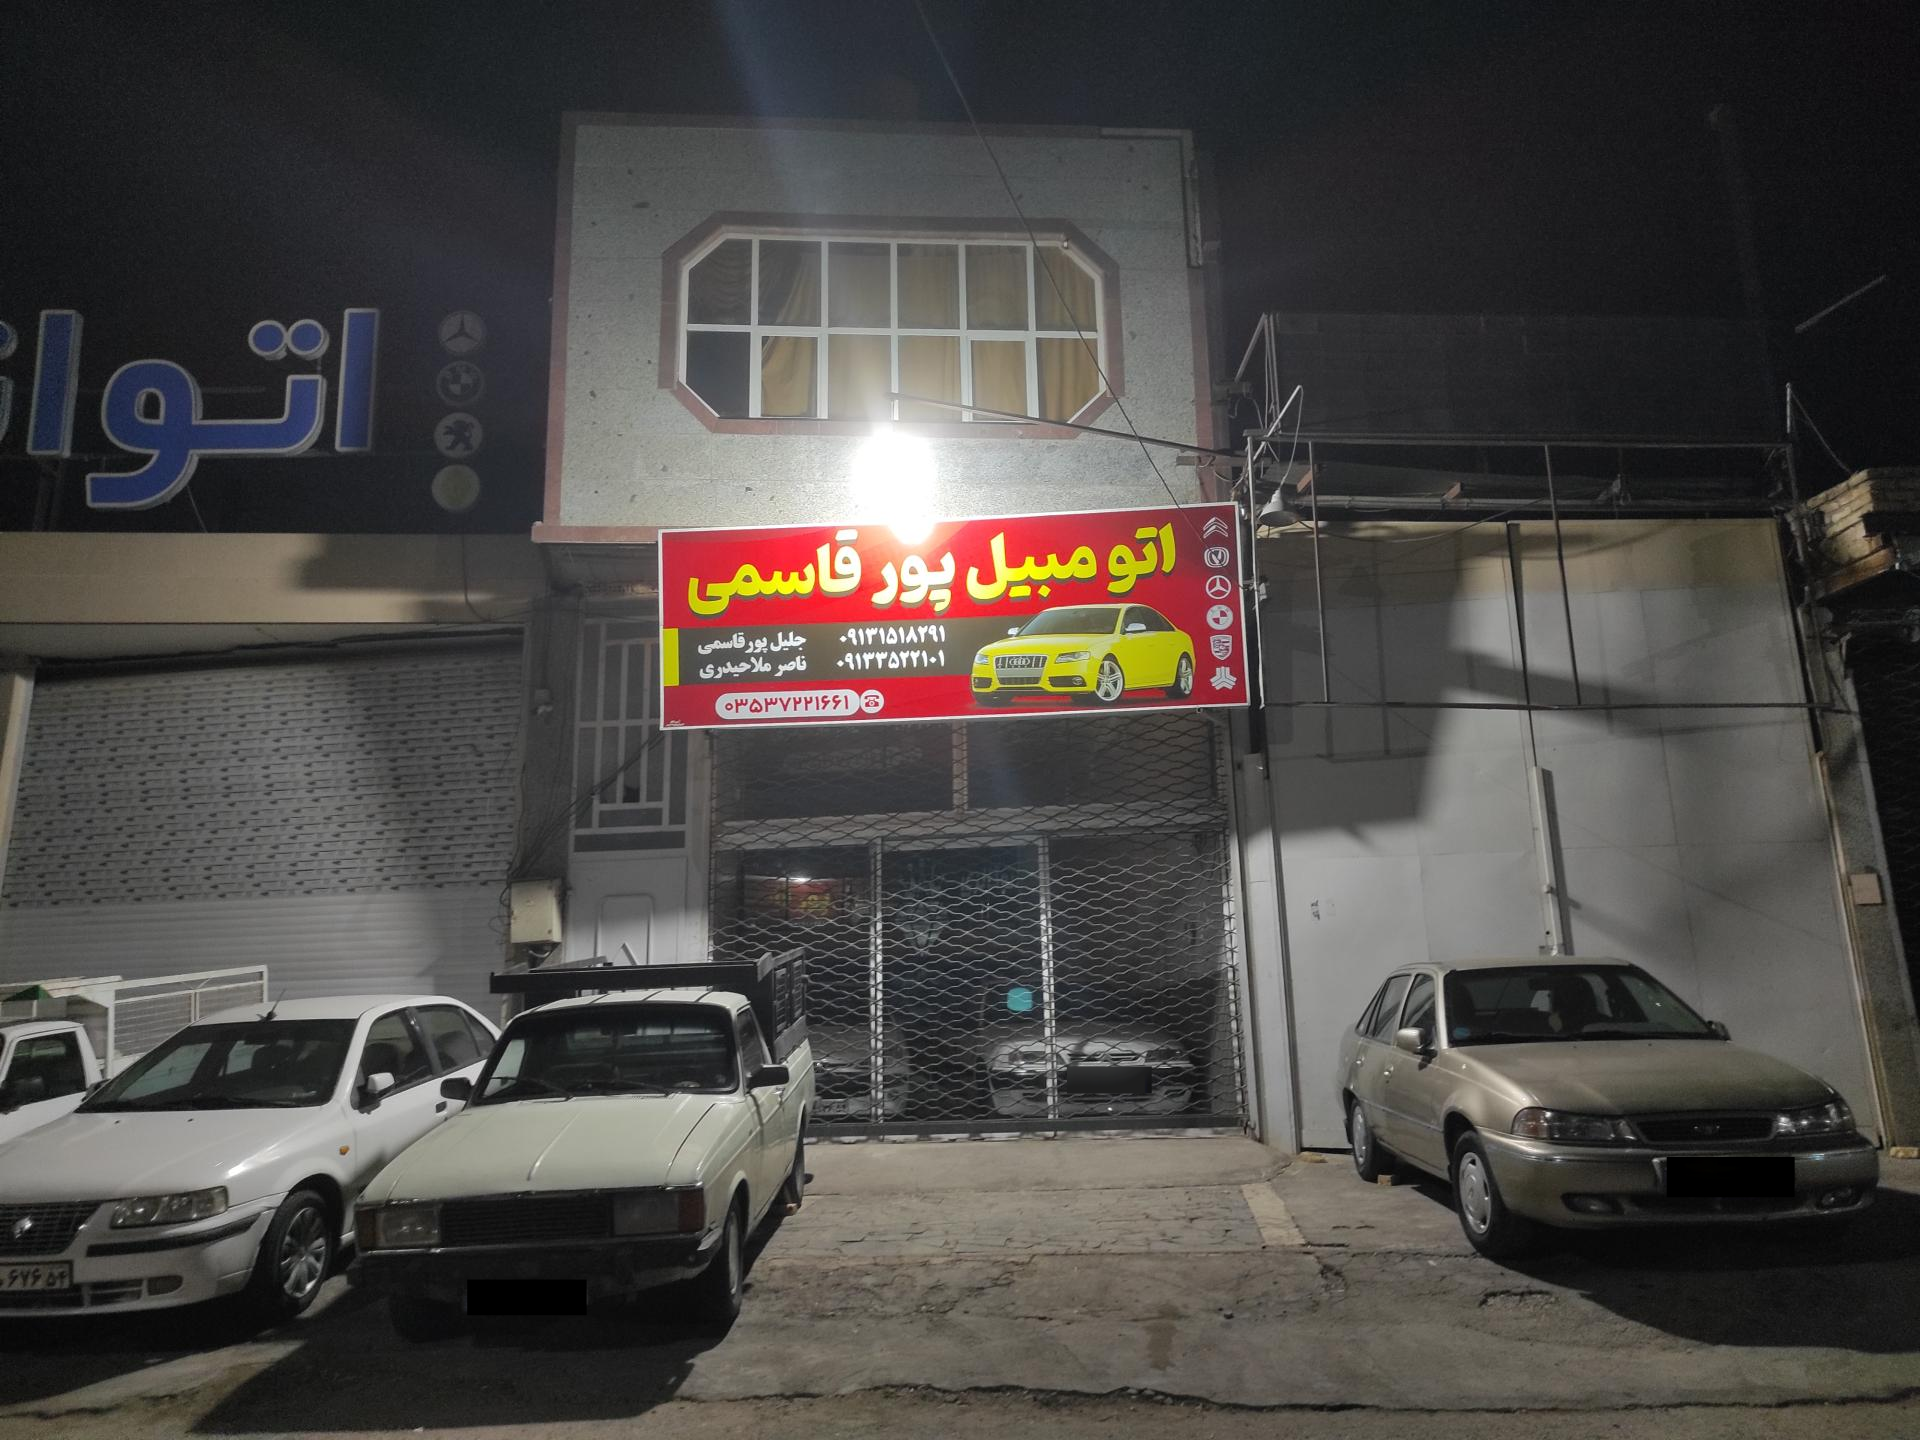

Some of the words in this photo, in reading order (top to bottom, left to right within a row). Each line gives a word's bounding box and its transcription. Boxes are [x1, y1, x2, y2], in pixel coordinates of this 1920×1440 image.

[687, 529, 862, 615] قاسمی
[870, 551, 956, 612] پور
[966, 531, 1098, 600] مبیل
[1107, 522, 1177, 593] اتو
[770, 630, 807, 652] جلیل
[773, 655, 807, 677] ناصر
